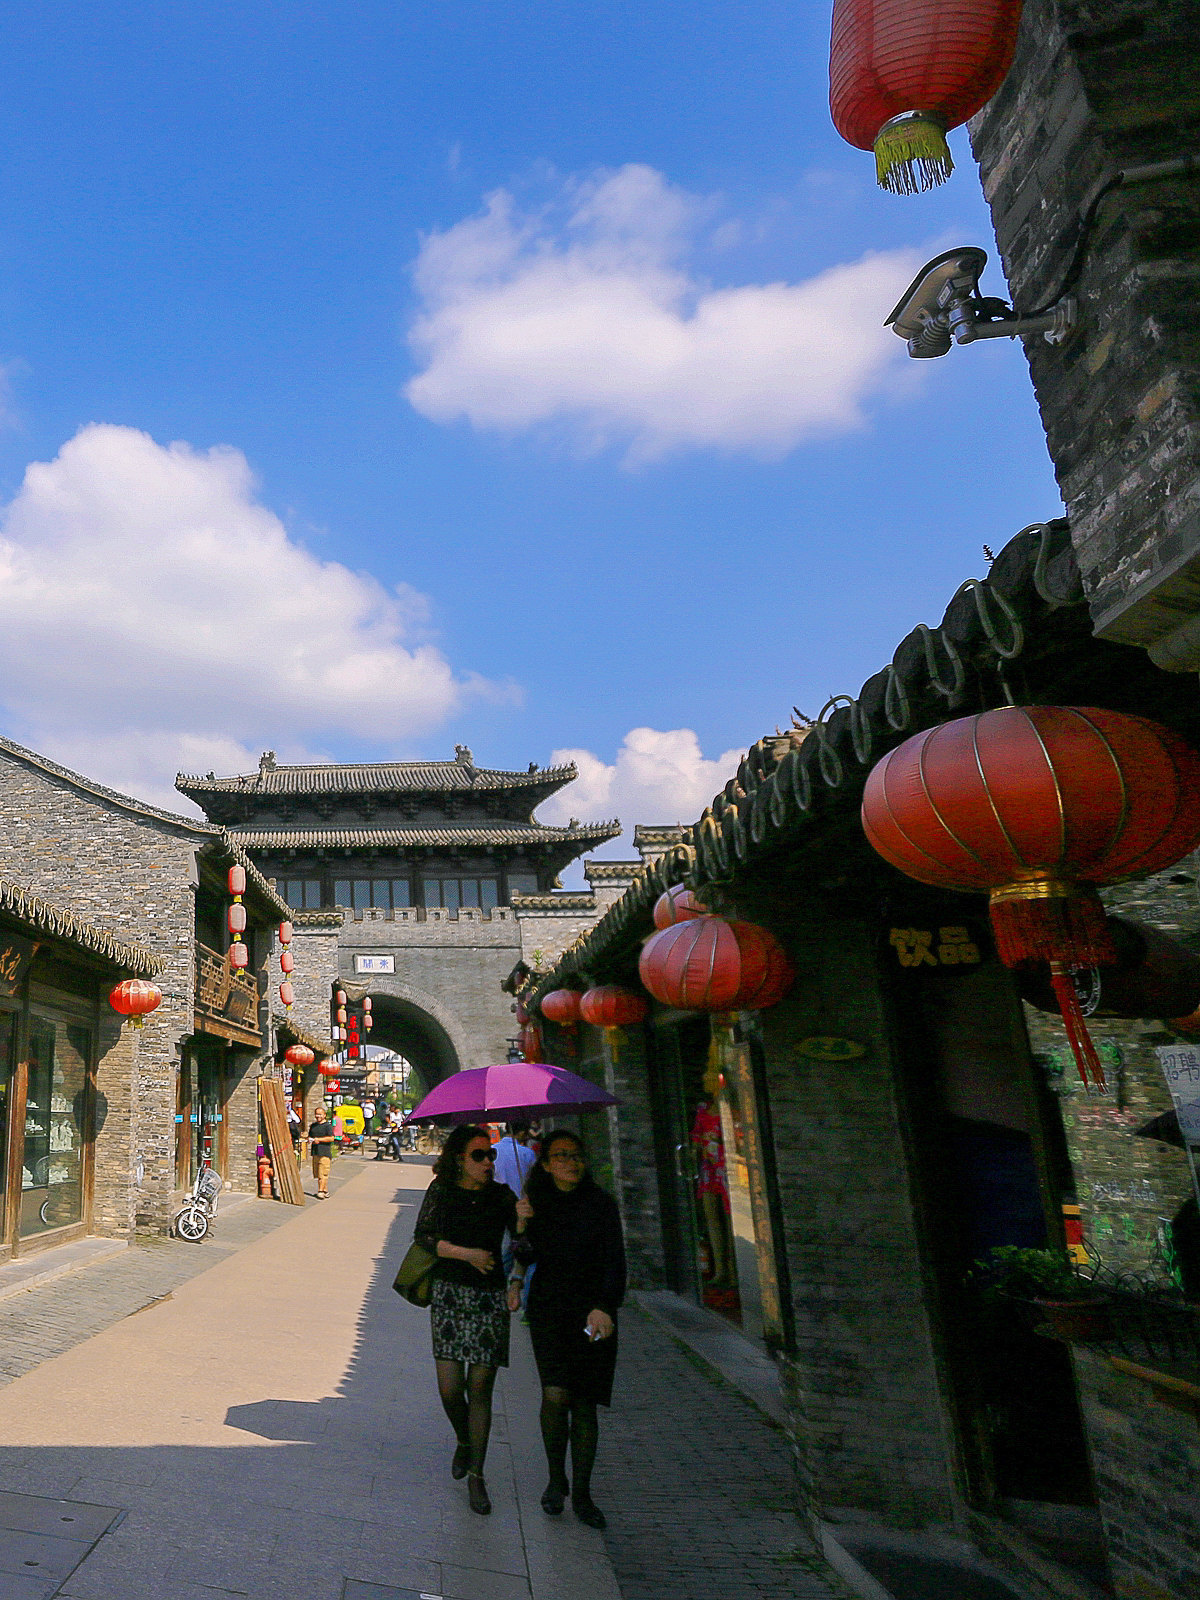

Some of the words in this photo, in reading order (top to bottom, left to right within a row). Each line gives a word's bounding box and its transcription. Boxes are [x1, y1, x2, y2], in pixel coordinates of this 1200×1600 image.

[889, 926, 981, 967] 饮品
[1162, 1051, 1200, 1082] 招聘
[327, 1081, 339, 1091] illy
